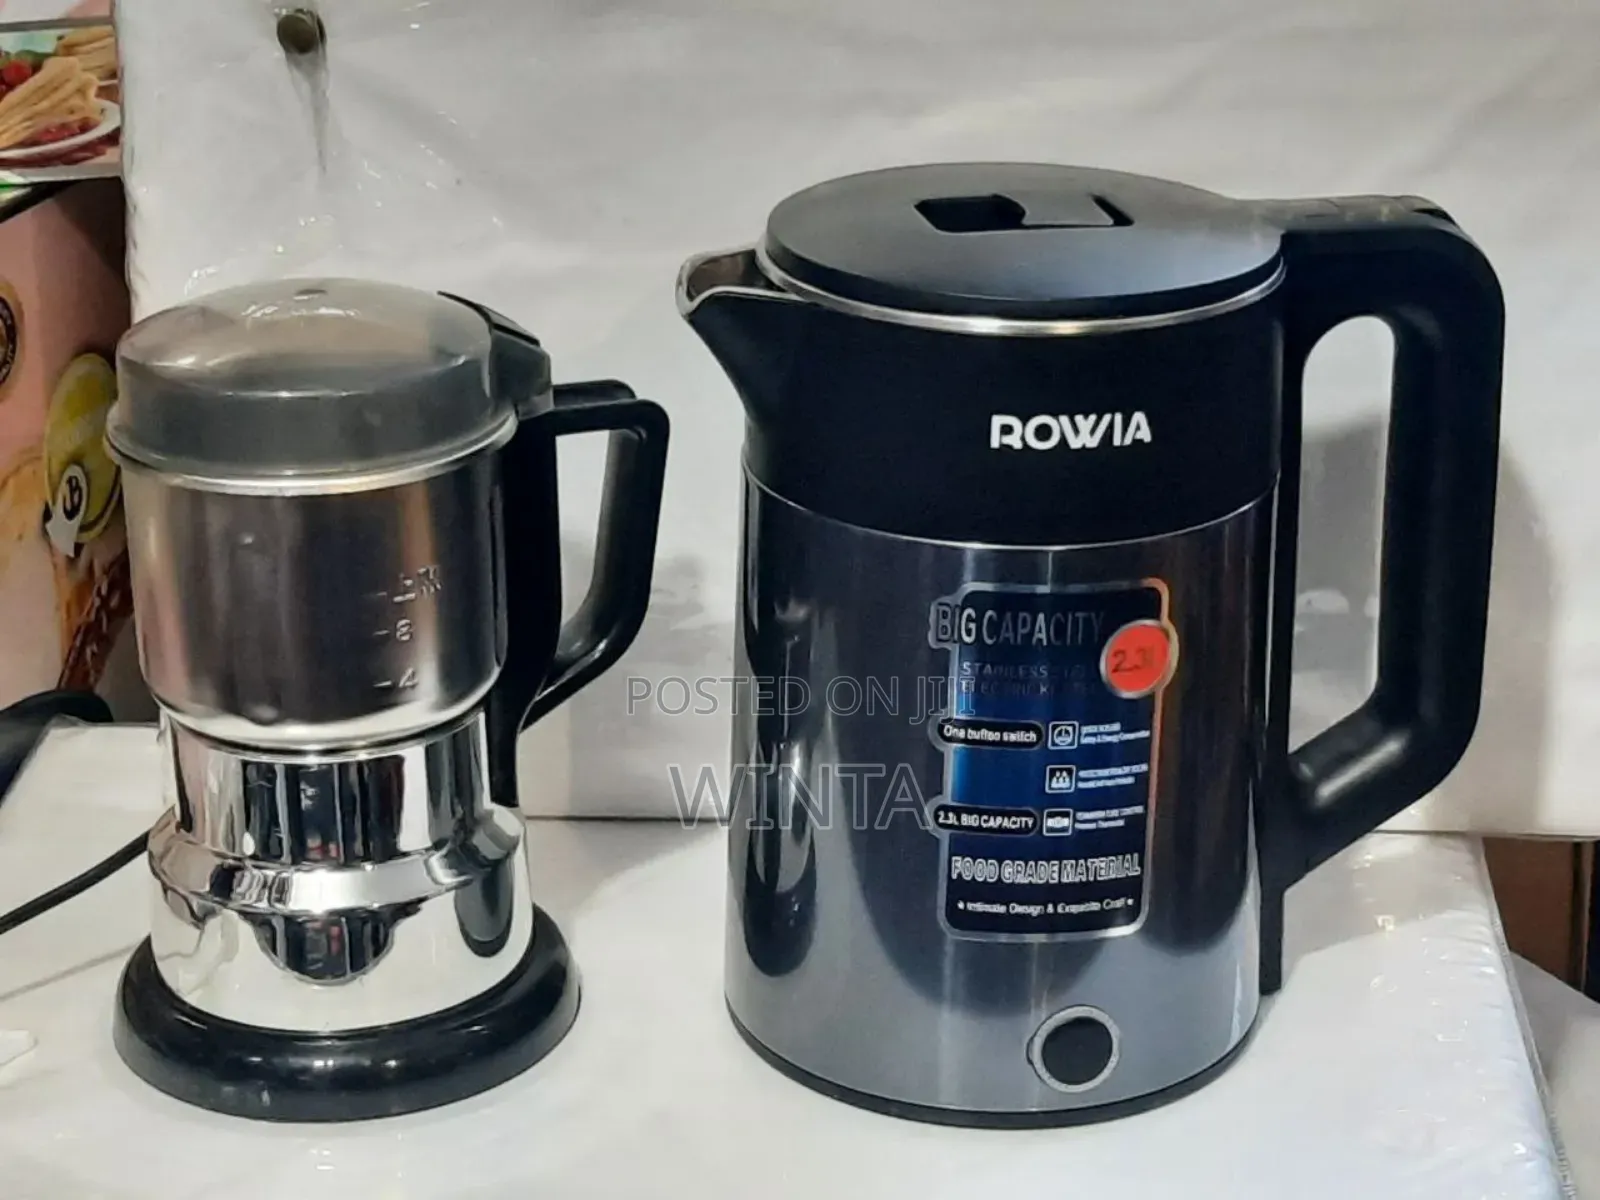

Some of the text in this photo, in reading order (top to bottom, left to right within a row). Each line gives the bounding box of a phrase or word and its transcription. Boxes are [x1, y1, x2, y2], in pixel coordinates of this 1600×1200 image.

[990, 411, 1152, 450] ROWIA
[936, 603, 1106, 647] BIG CAPACITY
[960, 814, 980, 827] BIG
[980, 815, 1034, 829] CAPACITY
[951, 853, 1141, 885] FOOD GRADE MATERIAL
